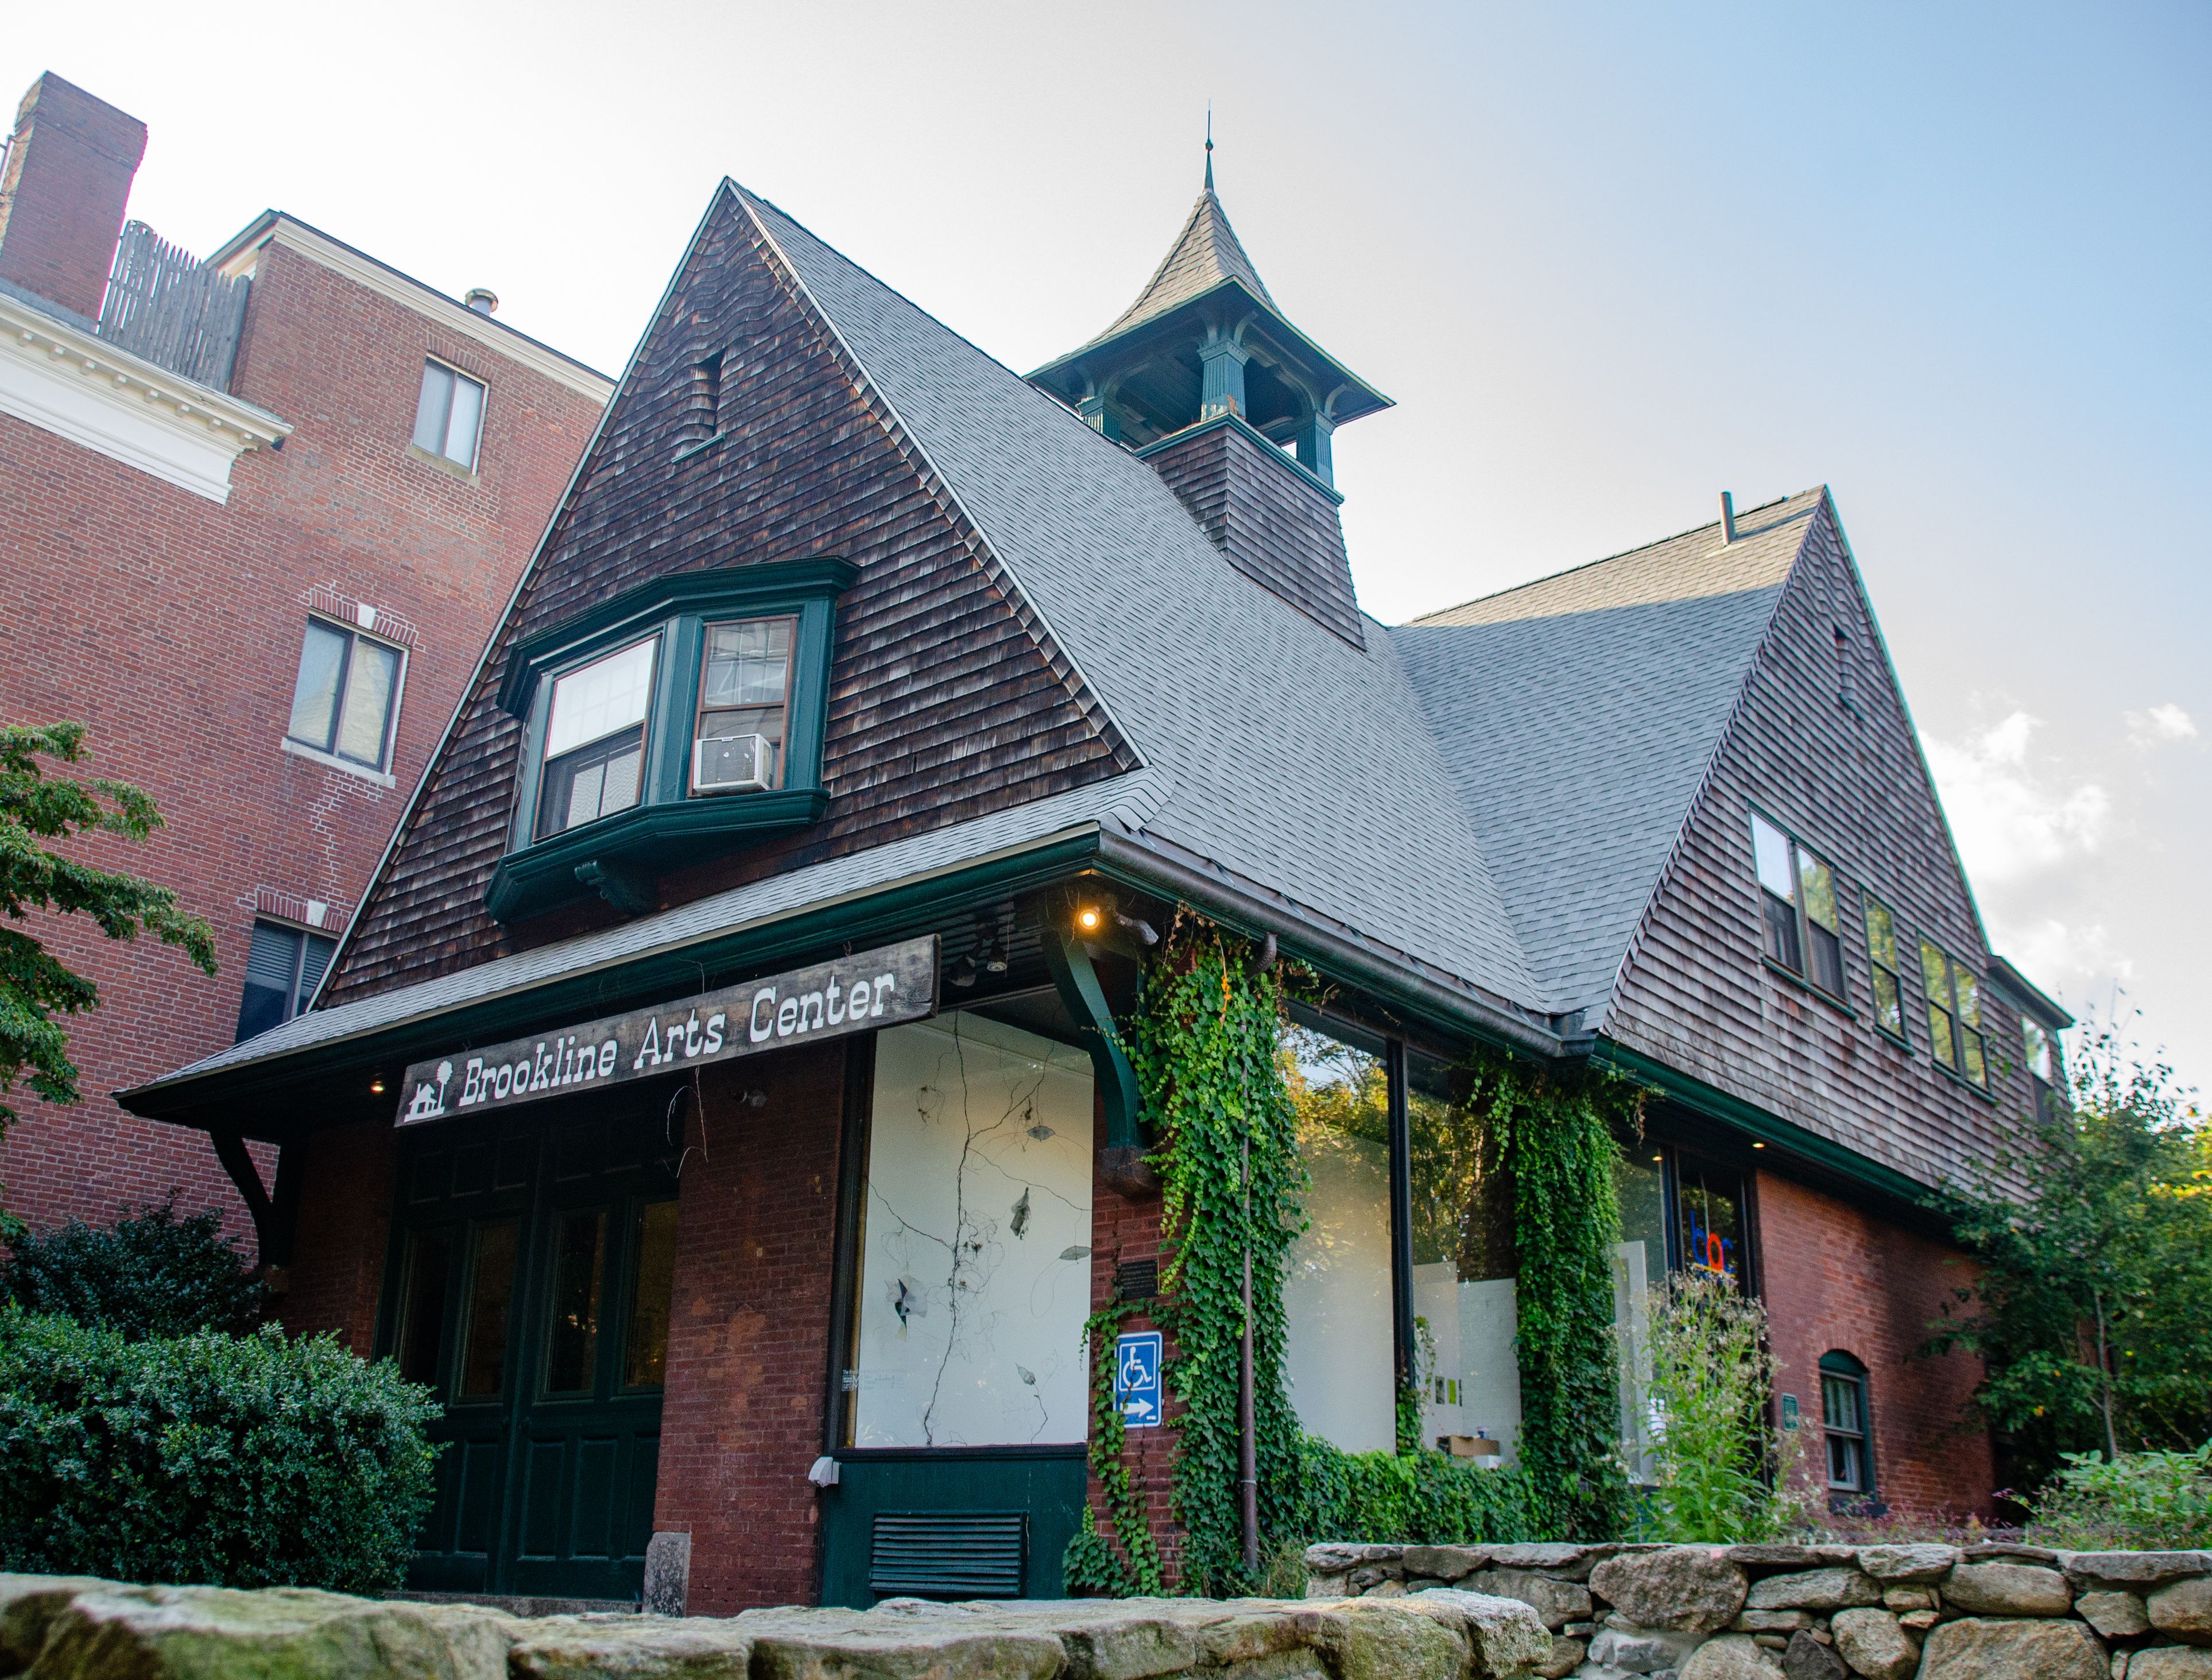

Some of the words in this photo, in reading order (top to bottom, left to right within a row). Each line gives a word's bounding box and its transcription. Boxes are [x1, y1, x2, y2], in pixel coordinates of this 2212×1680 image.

[459, 1036, 617, 1107] Brookline
[634, 1006, 726, 1070] Arts
[750, 973, 894, 1043] Center
